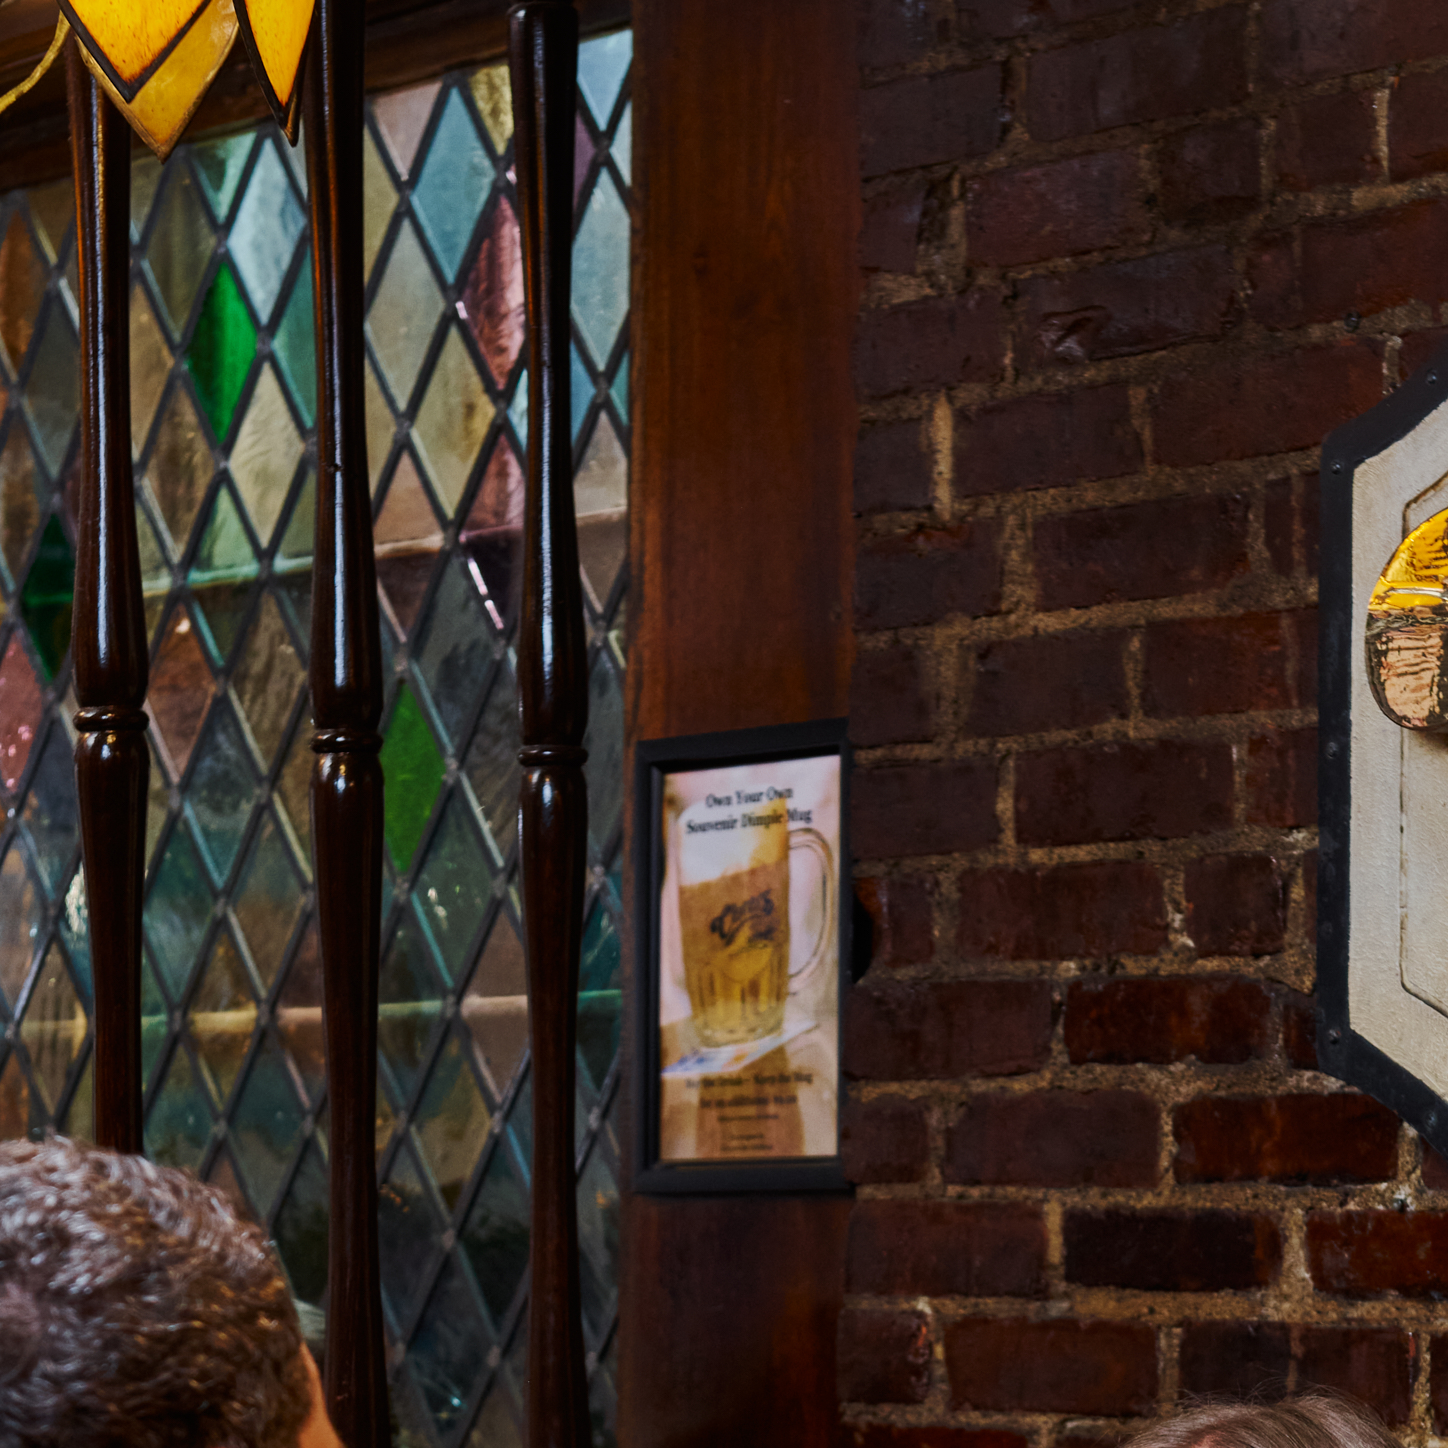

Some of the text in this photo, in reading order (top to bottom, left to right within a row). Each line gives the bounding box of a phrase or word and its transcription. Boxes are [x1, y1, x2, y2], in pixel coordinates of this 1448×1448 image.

[705, 786, 793, 807] Own Your Own
[686, 808, 812, 834] Souvenir Dimple Mug
